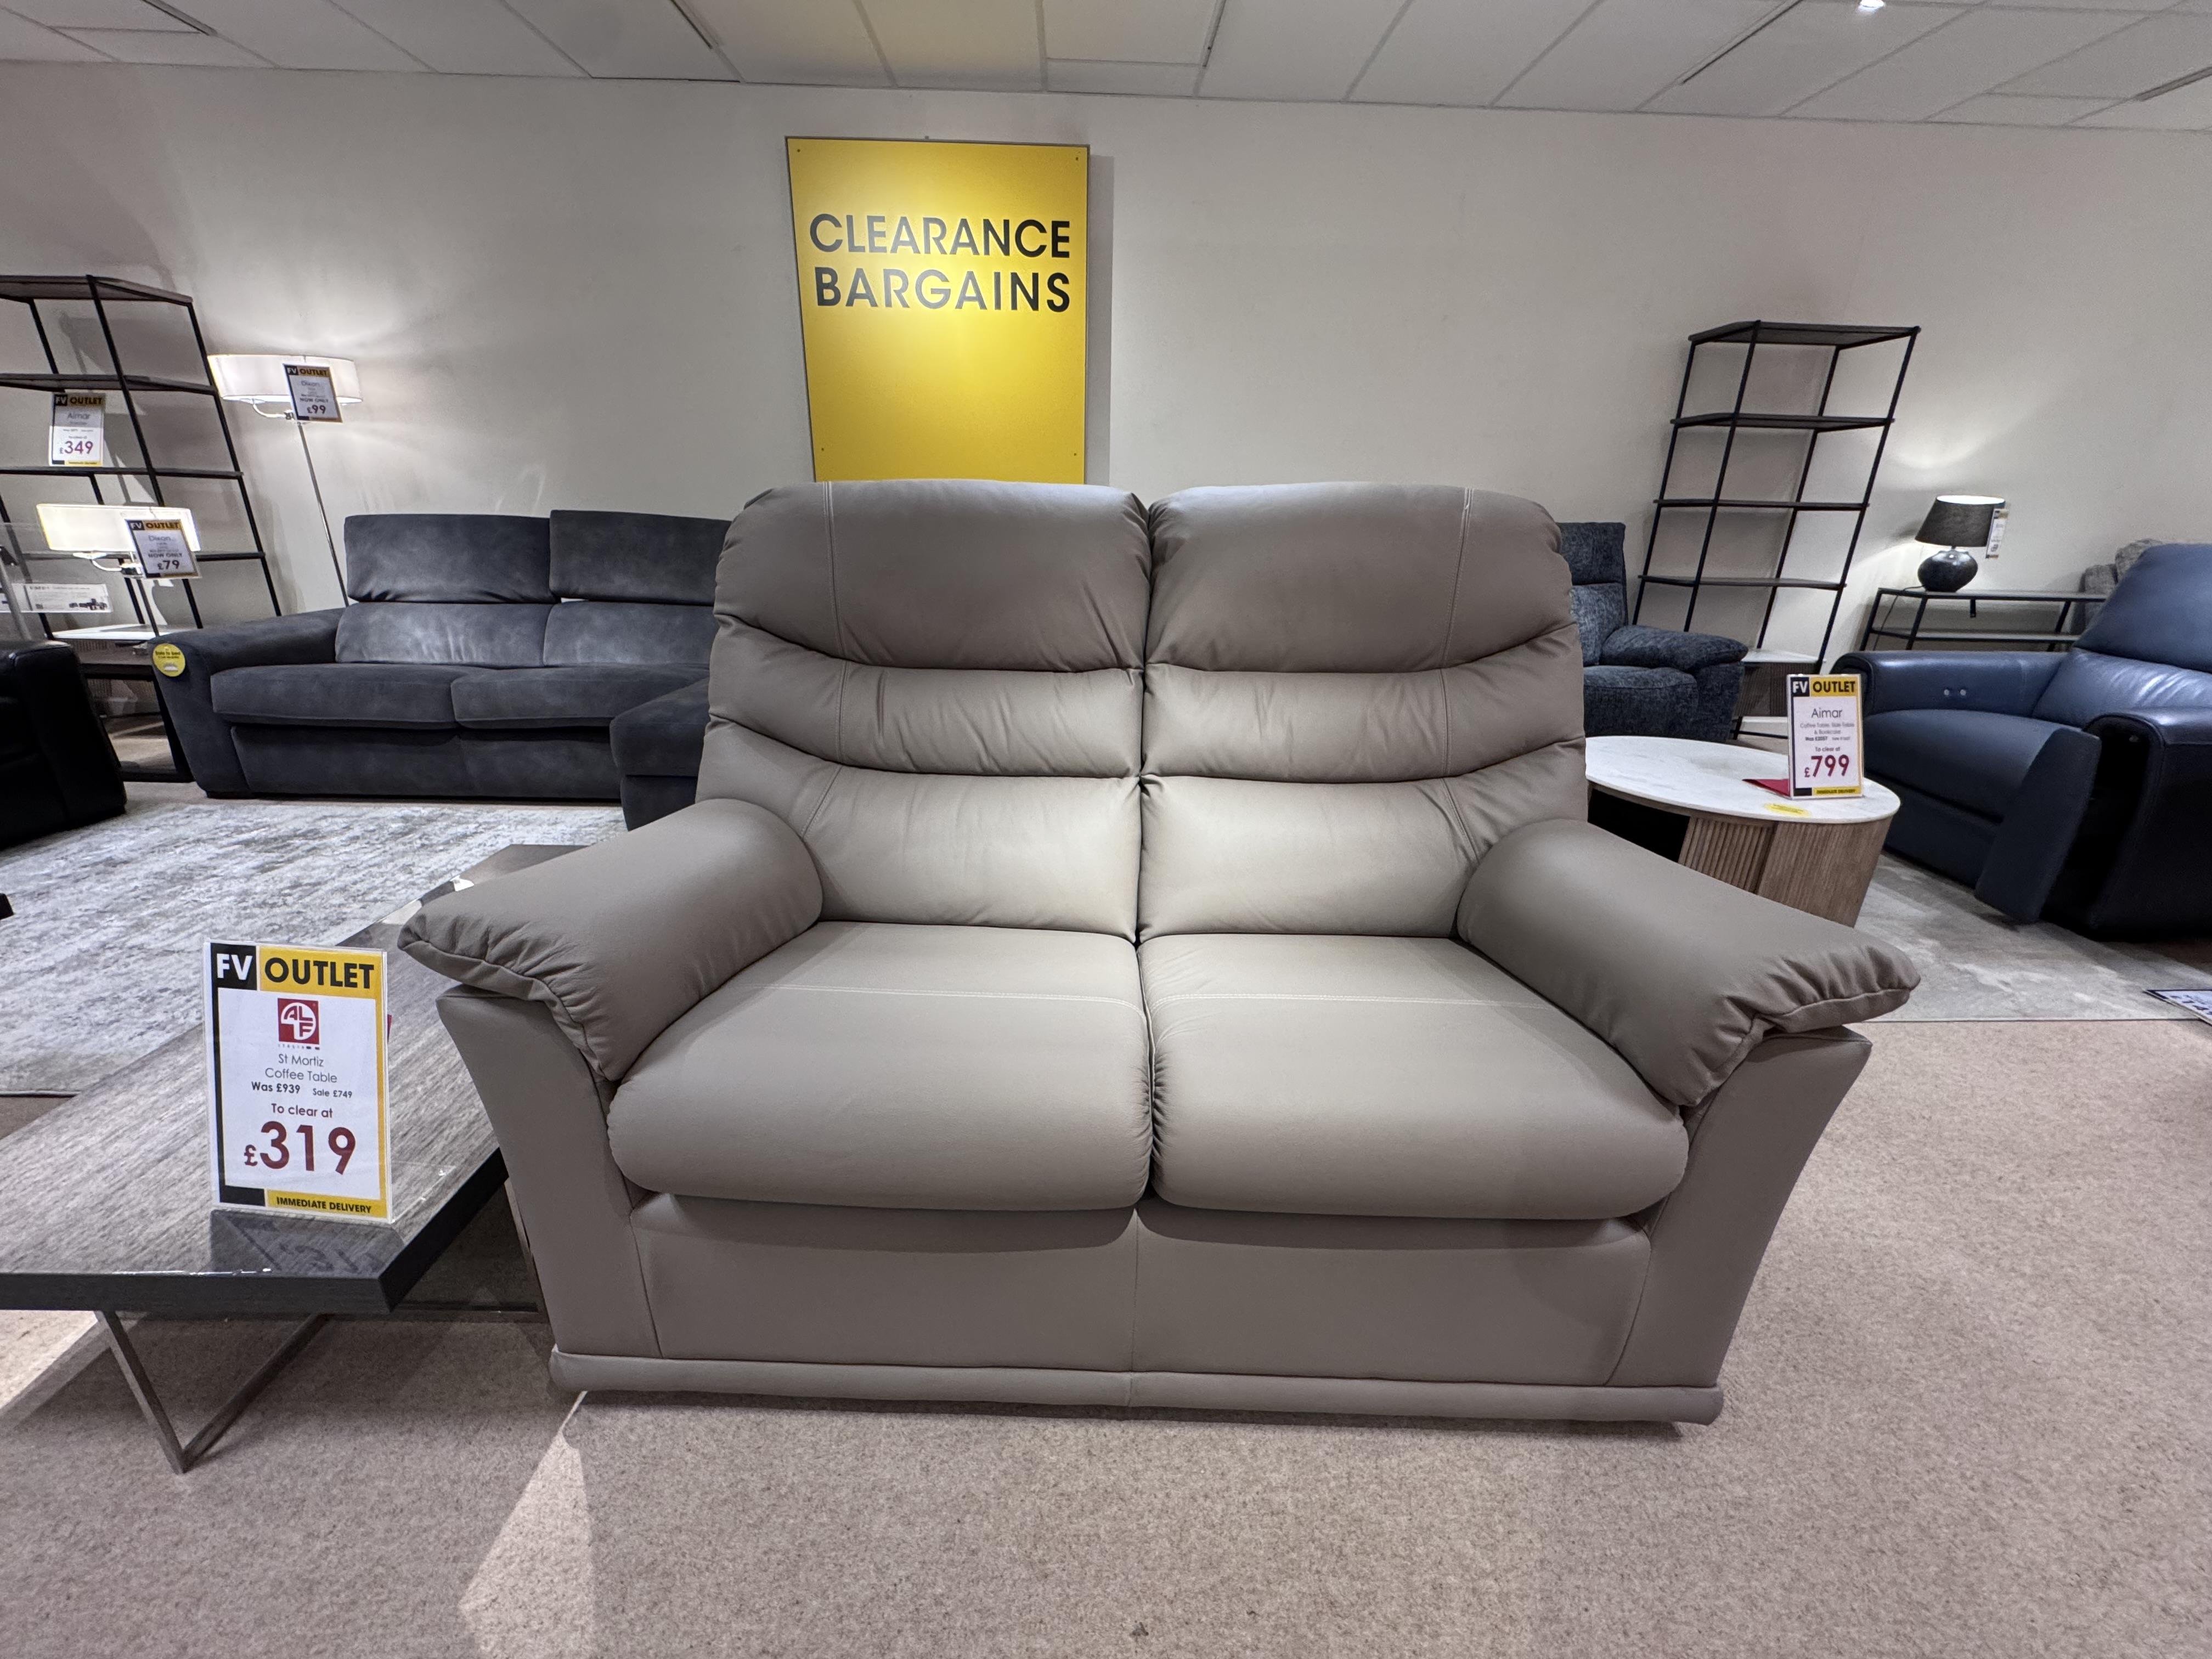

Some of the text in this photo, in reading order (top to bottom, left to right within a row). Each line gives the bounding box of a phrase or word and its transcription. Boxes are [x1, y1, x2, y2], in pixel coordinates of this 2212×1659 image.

[810, 212, 1070, 258] CLEARANCE
[815, 266, 1070, 313] BARGAINS
[70, 397, 102, 405] OUTLET
[307, 404, 326, 414] £99
[60, 441, 93, 455] £349
[157, 560, 180, 570] £79
[1792, 681, 1855, 693] FV OUTLET
[1811, 708, 1843, 719] Aimar
[1804, 754, 1850, 778] £799
[216, 953, 374, 990] FV OUTLET
[278, 1053, 324, 1068] St Mortiz
[265, 1067, 337, 1083] Coffee Table
[251, 1081, 353, 1099] Was £939 Sale £749
[271, 1103, 334, 1118] To clear at
[244, 1120, 357, 1175] £319
[276, 1196, 372, 1214] IMMEDIATE DELIVERY
